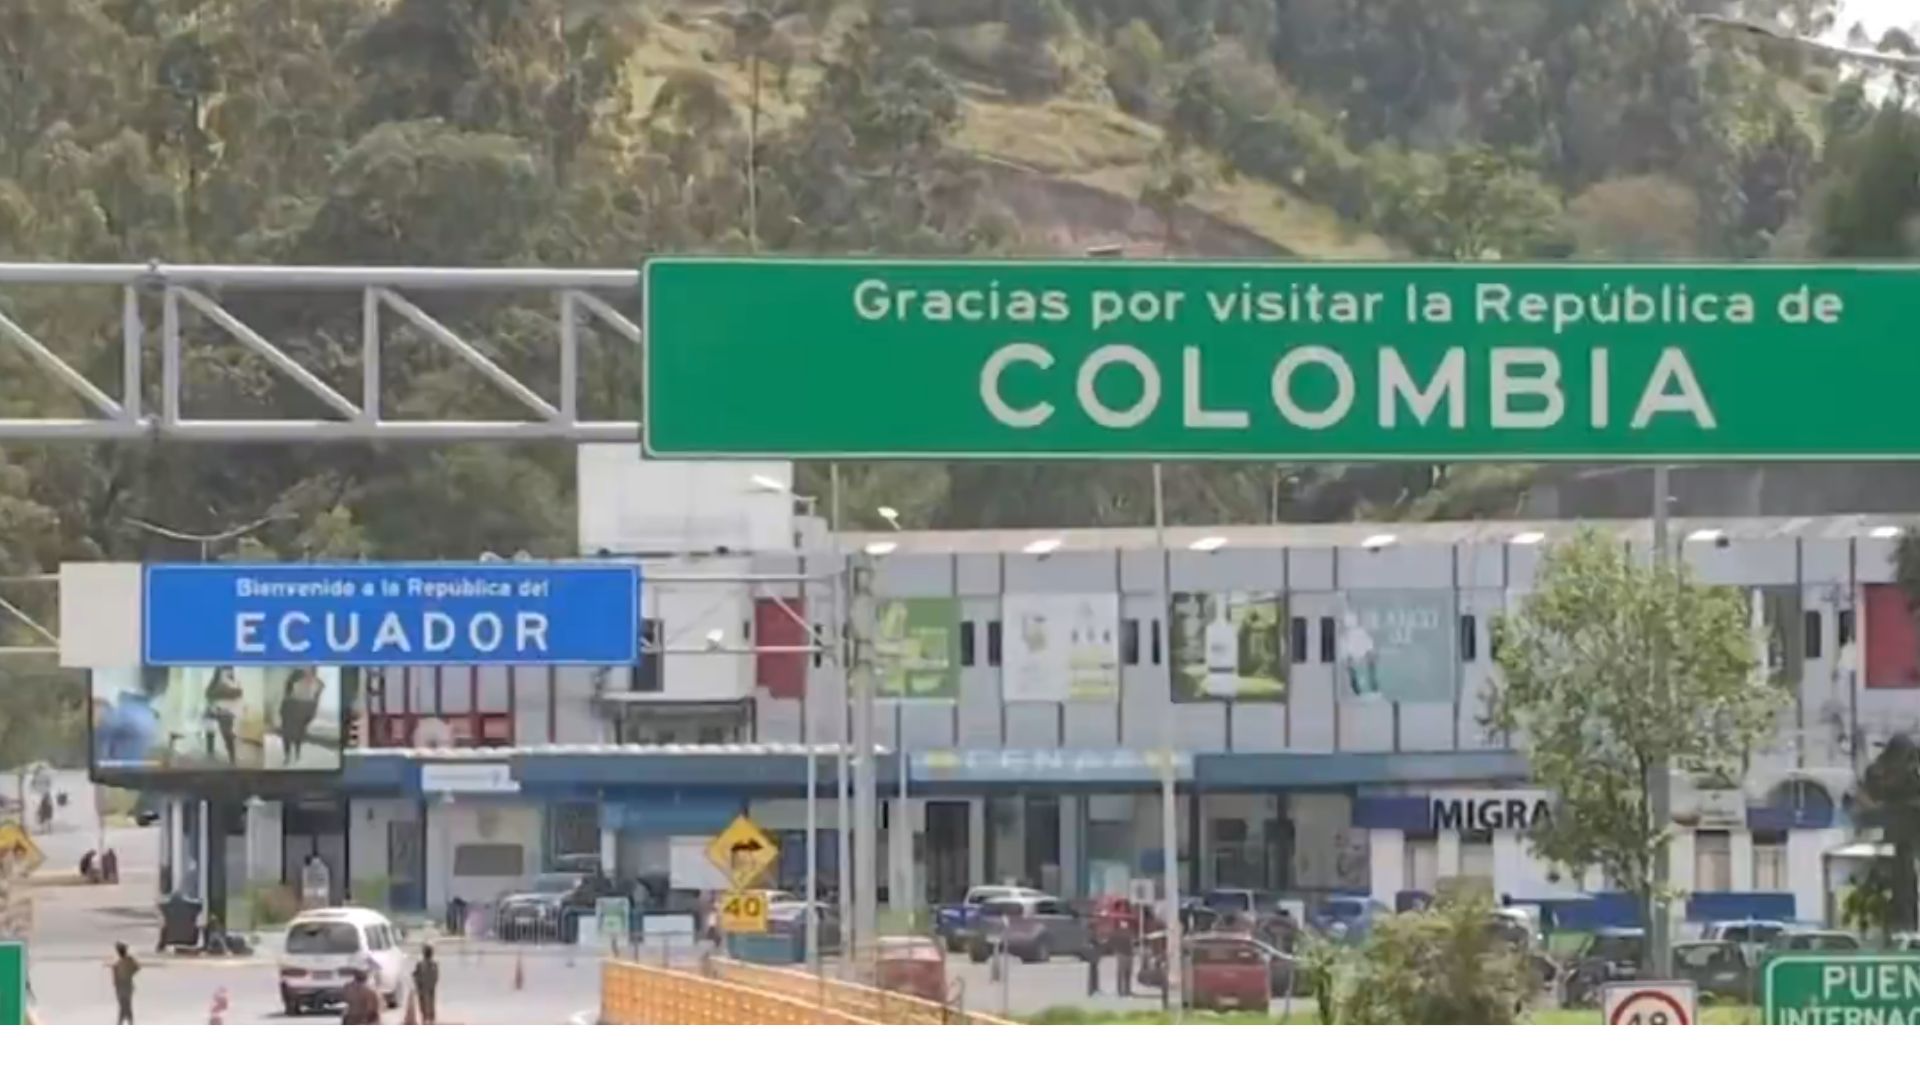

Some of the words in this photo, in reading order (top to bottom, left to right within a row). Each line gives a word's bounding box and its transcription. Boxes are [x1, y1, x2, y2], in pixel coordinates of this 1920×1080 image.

[853, 279, 1069, 321] Gracias
[1092, 289, 1184, 329] por
[1207, 282, 1384, 323] visitar
[1407, 283, 1452, 322] la
[1476, 282, 1755, 333] República
[1777, 285, 1843, 323] de
[980, 343, 1717, 430] COLOMBIA
[236, 577, 355, 597] Bienvenido
[362, 583, 374, 597] a
[382, 578, 400, 597] la
[408, 577, 511, 599] República
[518, 579, 549, 597] del
[235, 611, 549, 652] ECUADOR
[1433, 799, 1553, 829] MIGRA
[723, 897, 761, 918] 40
[1824, 964, 1920, 1000] PUEN
